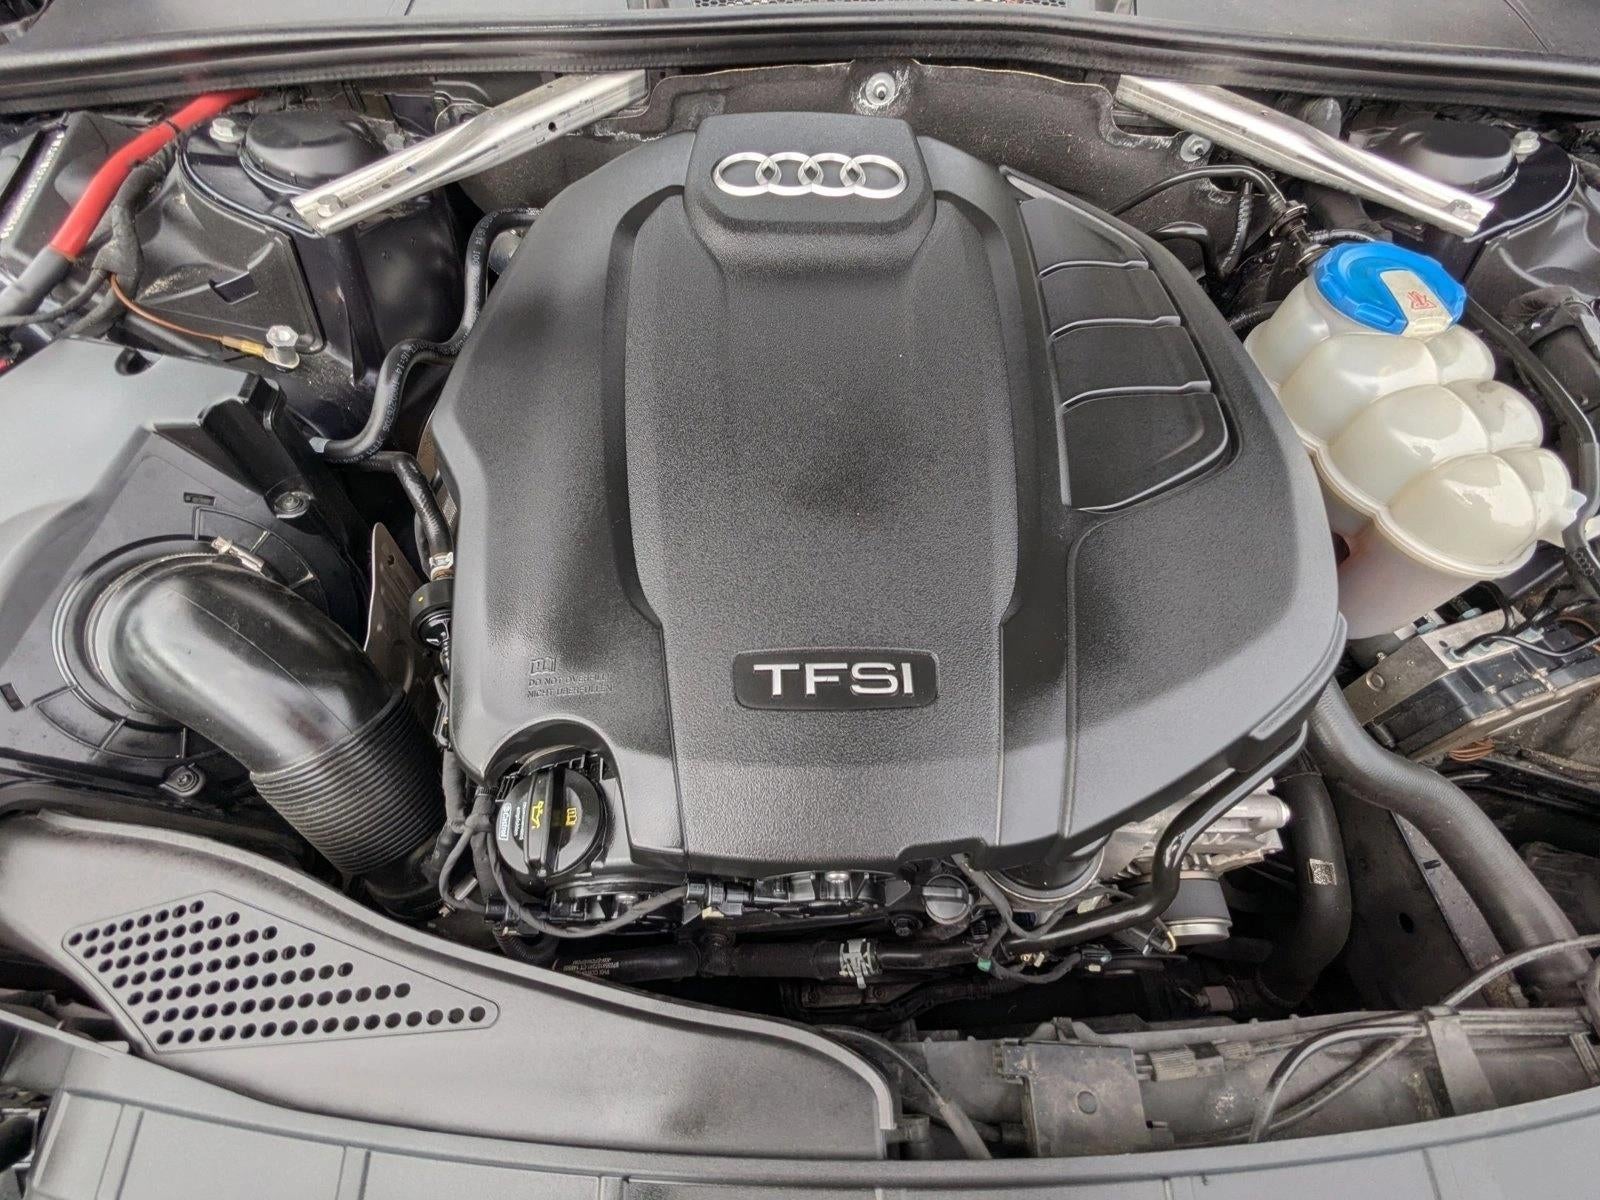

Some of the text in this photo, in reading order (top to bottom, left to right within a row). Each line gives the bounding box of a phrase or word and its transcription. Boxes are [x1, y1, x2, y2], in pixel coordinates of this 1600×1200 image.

[528, 678, 542, 687] DO
[543, 676, 563, 686] NOT
[753, 662, 914, 697] TFSI
